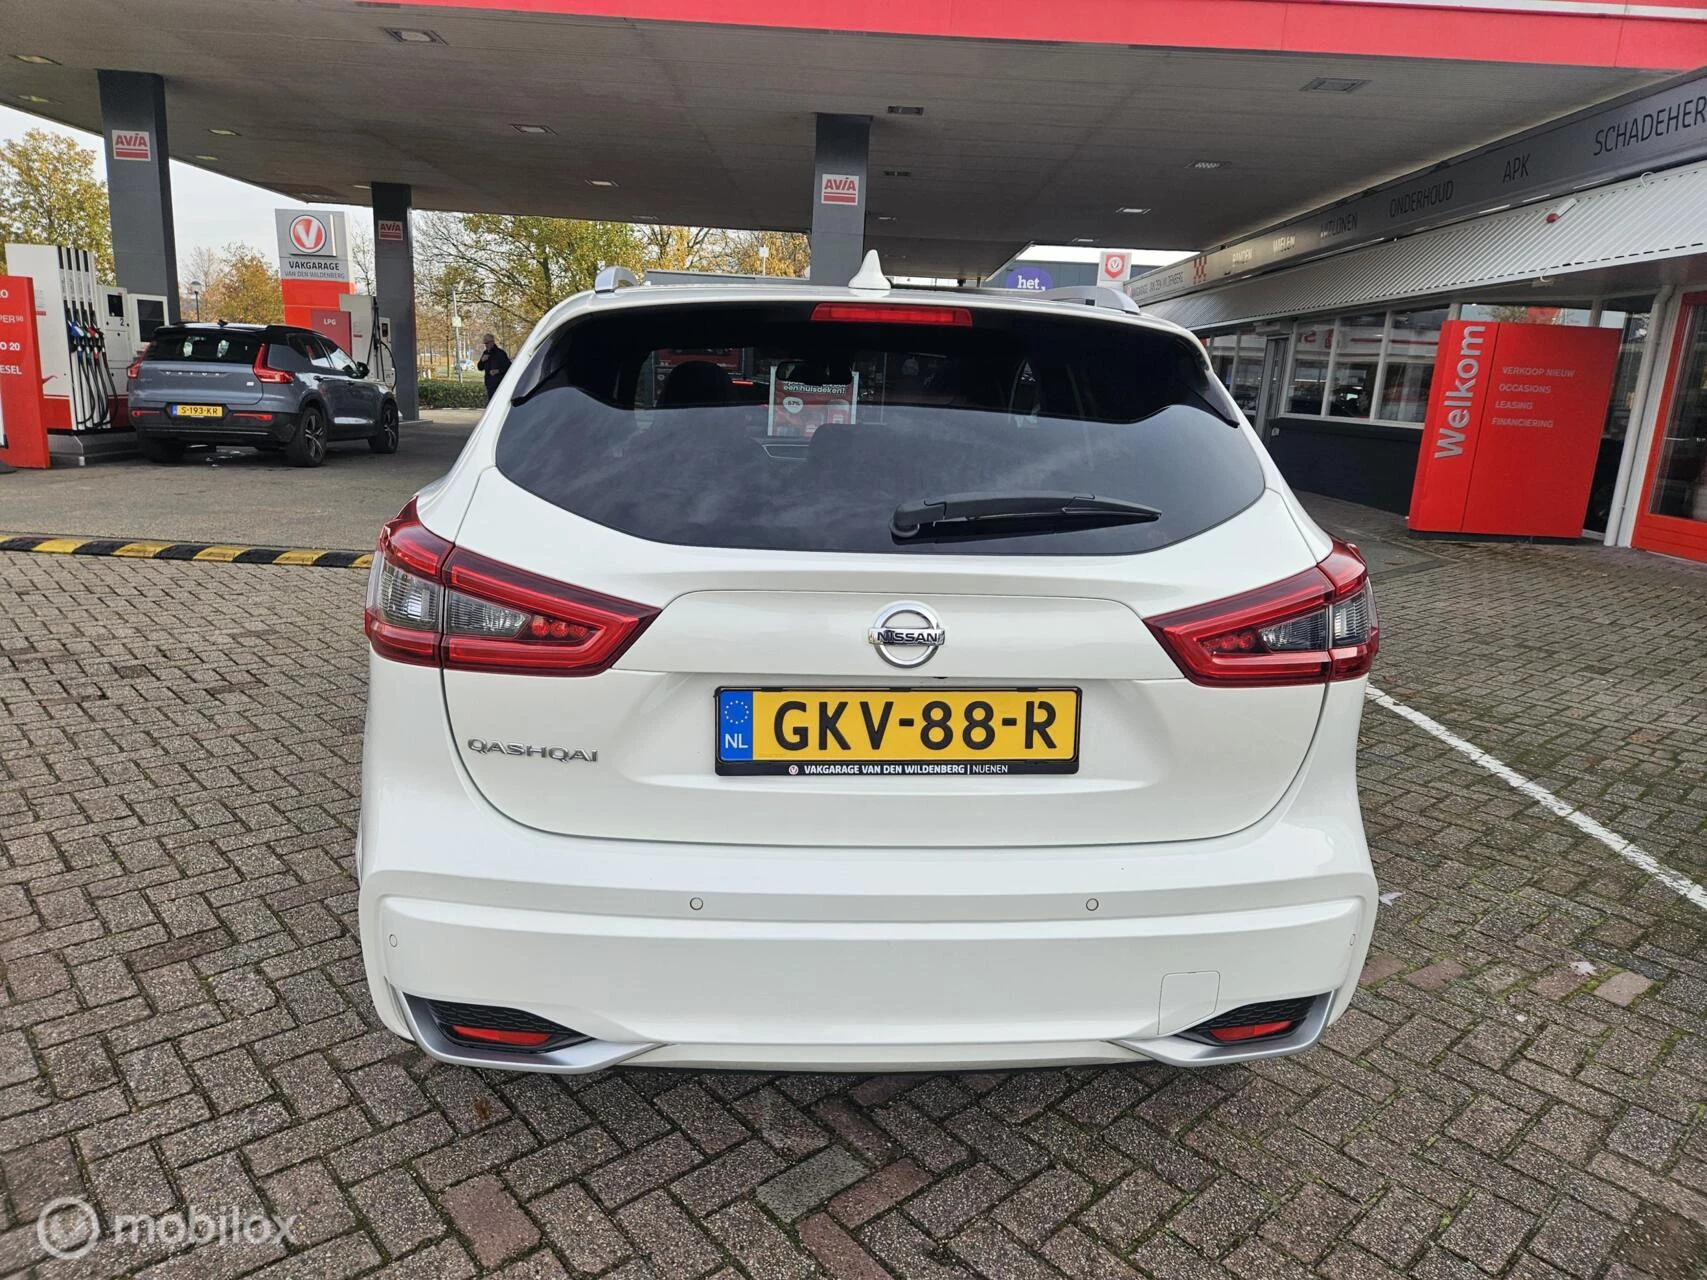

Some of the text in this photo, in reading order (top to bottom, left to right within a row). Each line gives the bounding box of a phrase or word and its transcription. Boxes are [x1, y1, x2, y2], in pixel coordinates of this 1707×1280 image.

[1593, 96, 1707, 156] SCHADEHER
[1503, 153, 1530, 183] APK
[1389, 180, 1454, 218] ONDERHOUD
[288, 261, 339, 271] VAKGARAGE
[1017, 275, 1040, 289] het
[10, 343, 20, 351] 20
[1502, 366, 1575, 378] VERKOOP NIEUW
[1434, 325, 1486, 459] Welkom
[1499, 383, 1552, 393] OCCASIONS
[181, 407, 218, 415] S-193-KR
[1495, 401, 1533, 410] LEASING
[1491, 417, 1554, 428] FINANCIERING
[877, 631, 937, 642] NISSAN
[774, 701, 1057, 750] GKV-88-R
[724, 733, 748, 748] NL
[467, 738, 598, 763] QASHQAI
[804, 765, 1008, 774] VAKGARAGE VAN DEN WILDENBERG NUENEN
